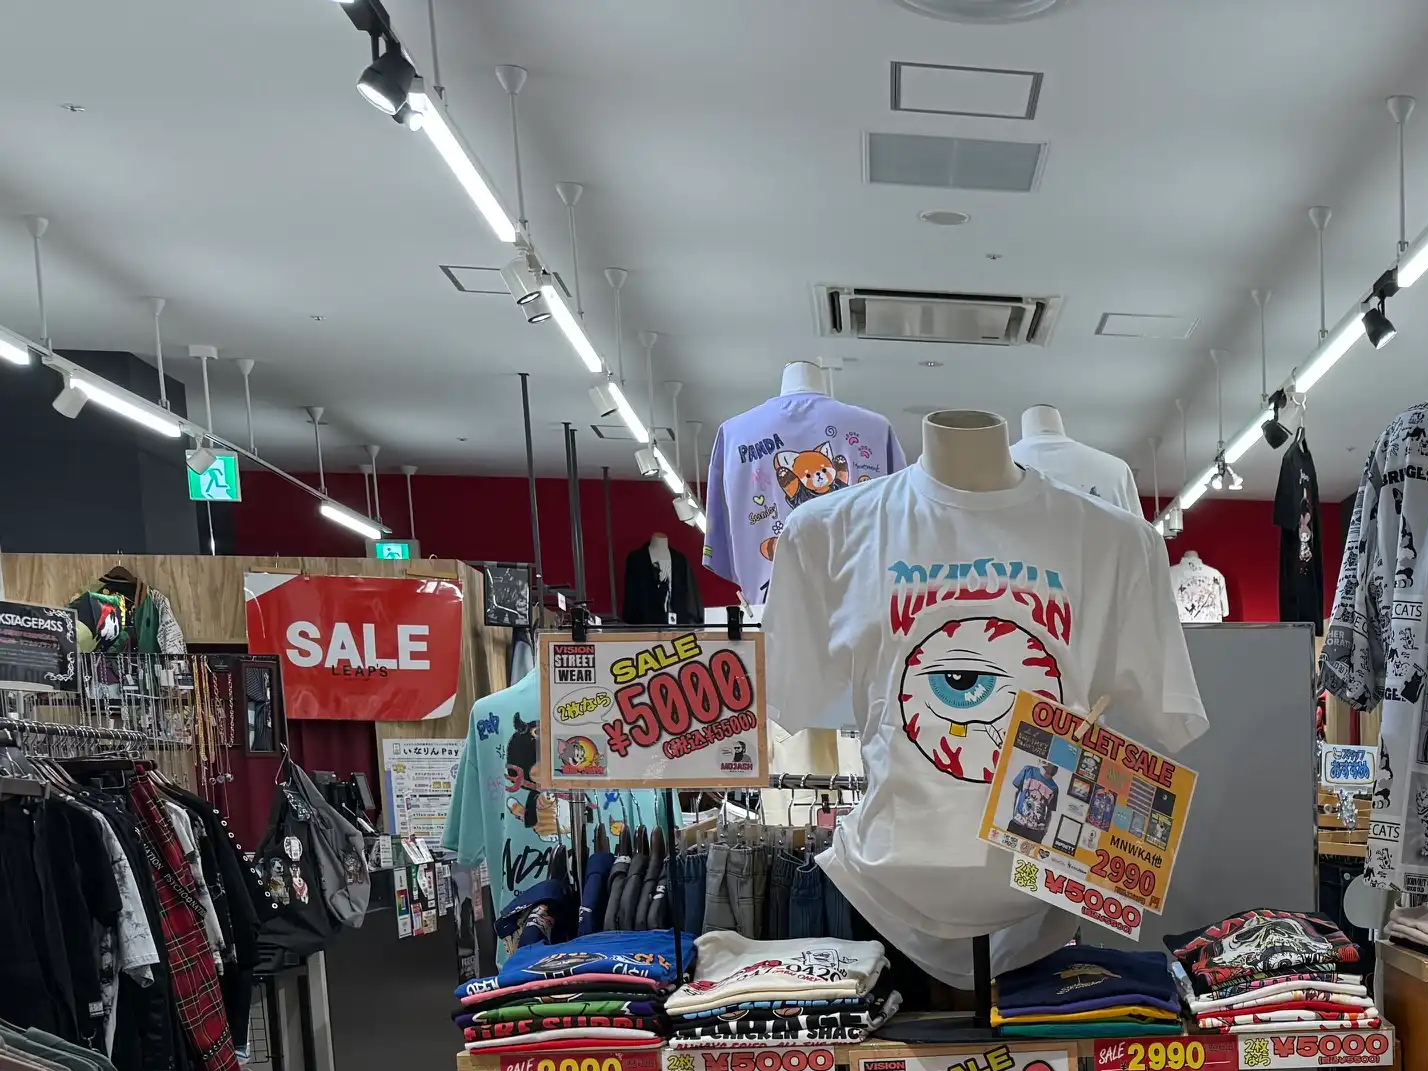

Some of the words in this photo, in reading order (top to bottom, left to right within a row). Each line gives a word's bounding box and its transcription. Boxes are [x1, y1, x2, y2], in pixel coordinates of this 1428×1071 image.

[738, 434, 785, 463] PANDA
[749, 503, 780, 526] Sunday
[1395, 604, 1423, 617] CATS
[286, 621, 430, 670] SALE
[555, 655, 594, 667] STREET
[610, 633, 702, 684] SALE
[331, 664, 388, 678] LEAP'S
[559, 669, 592, 682] WEAR
[557, 692, 611, 721] 2枚なら
[602, 649, 753, 757] ¥5000
[403, 747, 439, 756] いなりん
[441, 748, 459, 756] Pay
[1032, 701, 1125, 762] OUTLET
[1122, 743, 1176, 789] SALE
[1330, 761, 1370, 779] おすすめ
[1372, 823, 1400, 839] CATS
[1090, 848, 1156, 897] 2990
[1044, 868, 1141, 928] ¥5000
[1099, 1042, 1125, 1064] SALE
[1270, 1034, 1389, 1058] ¥5000
[866, 1061, 904, 1070] VISION
[1244, 1053, 1271, 1066] なら
